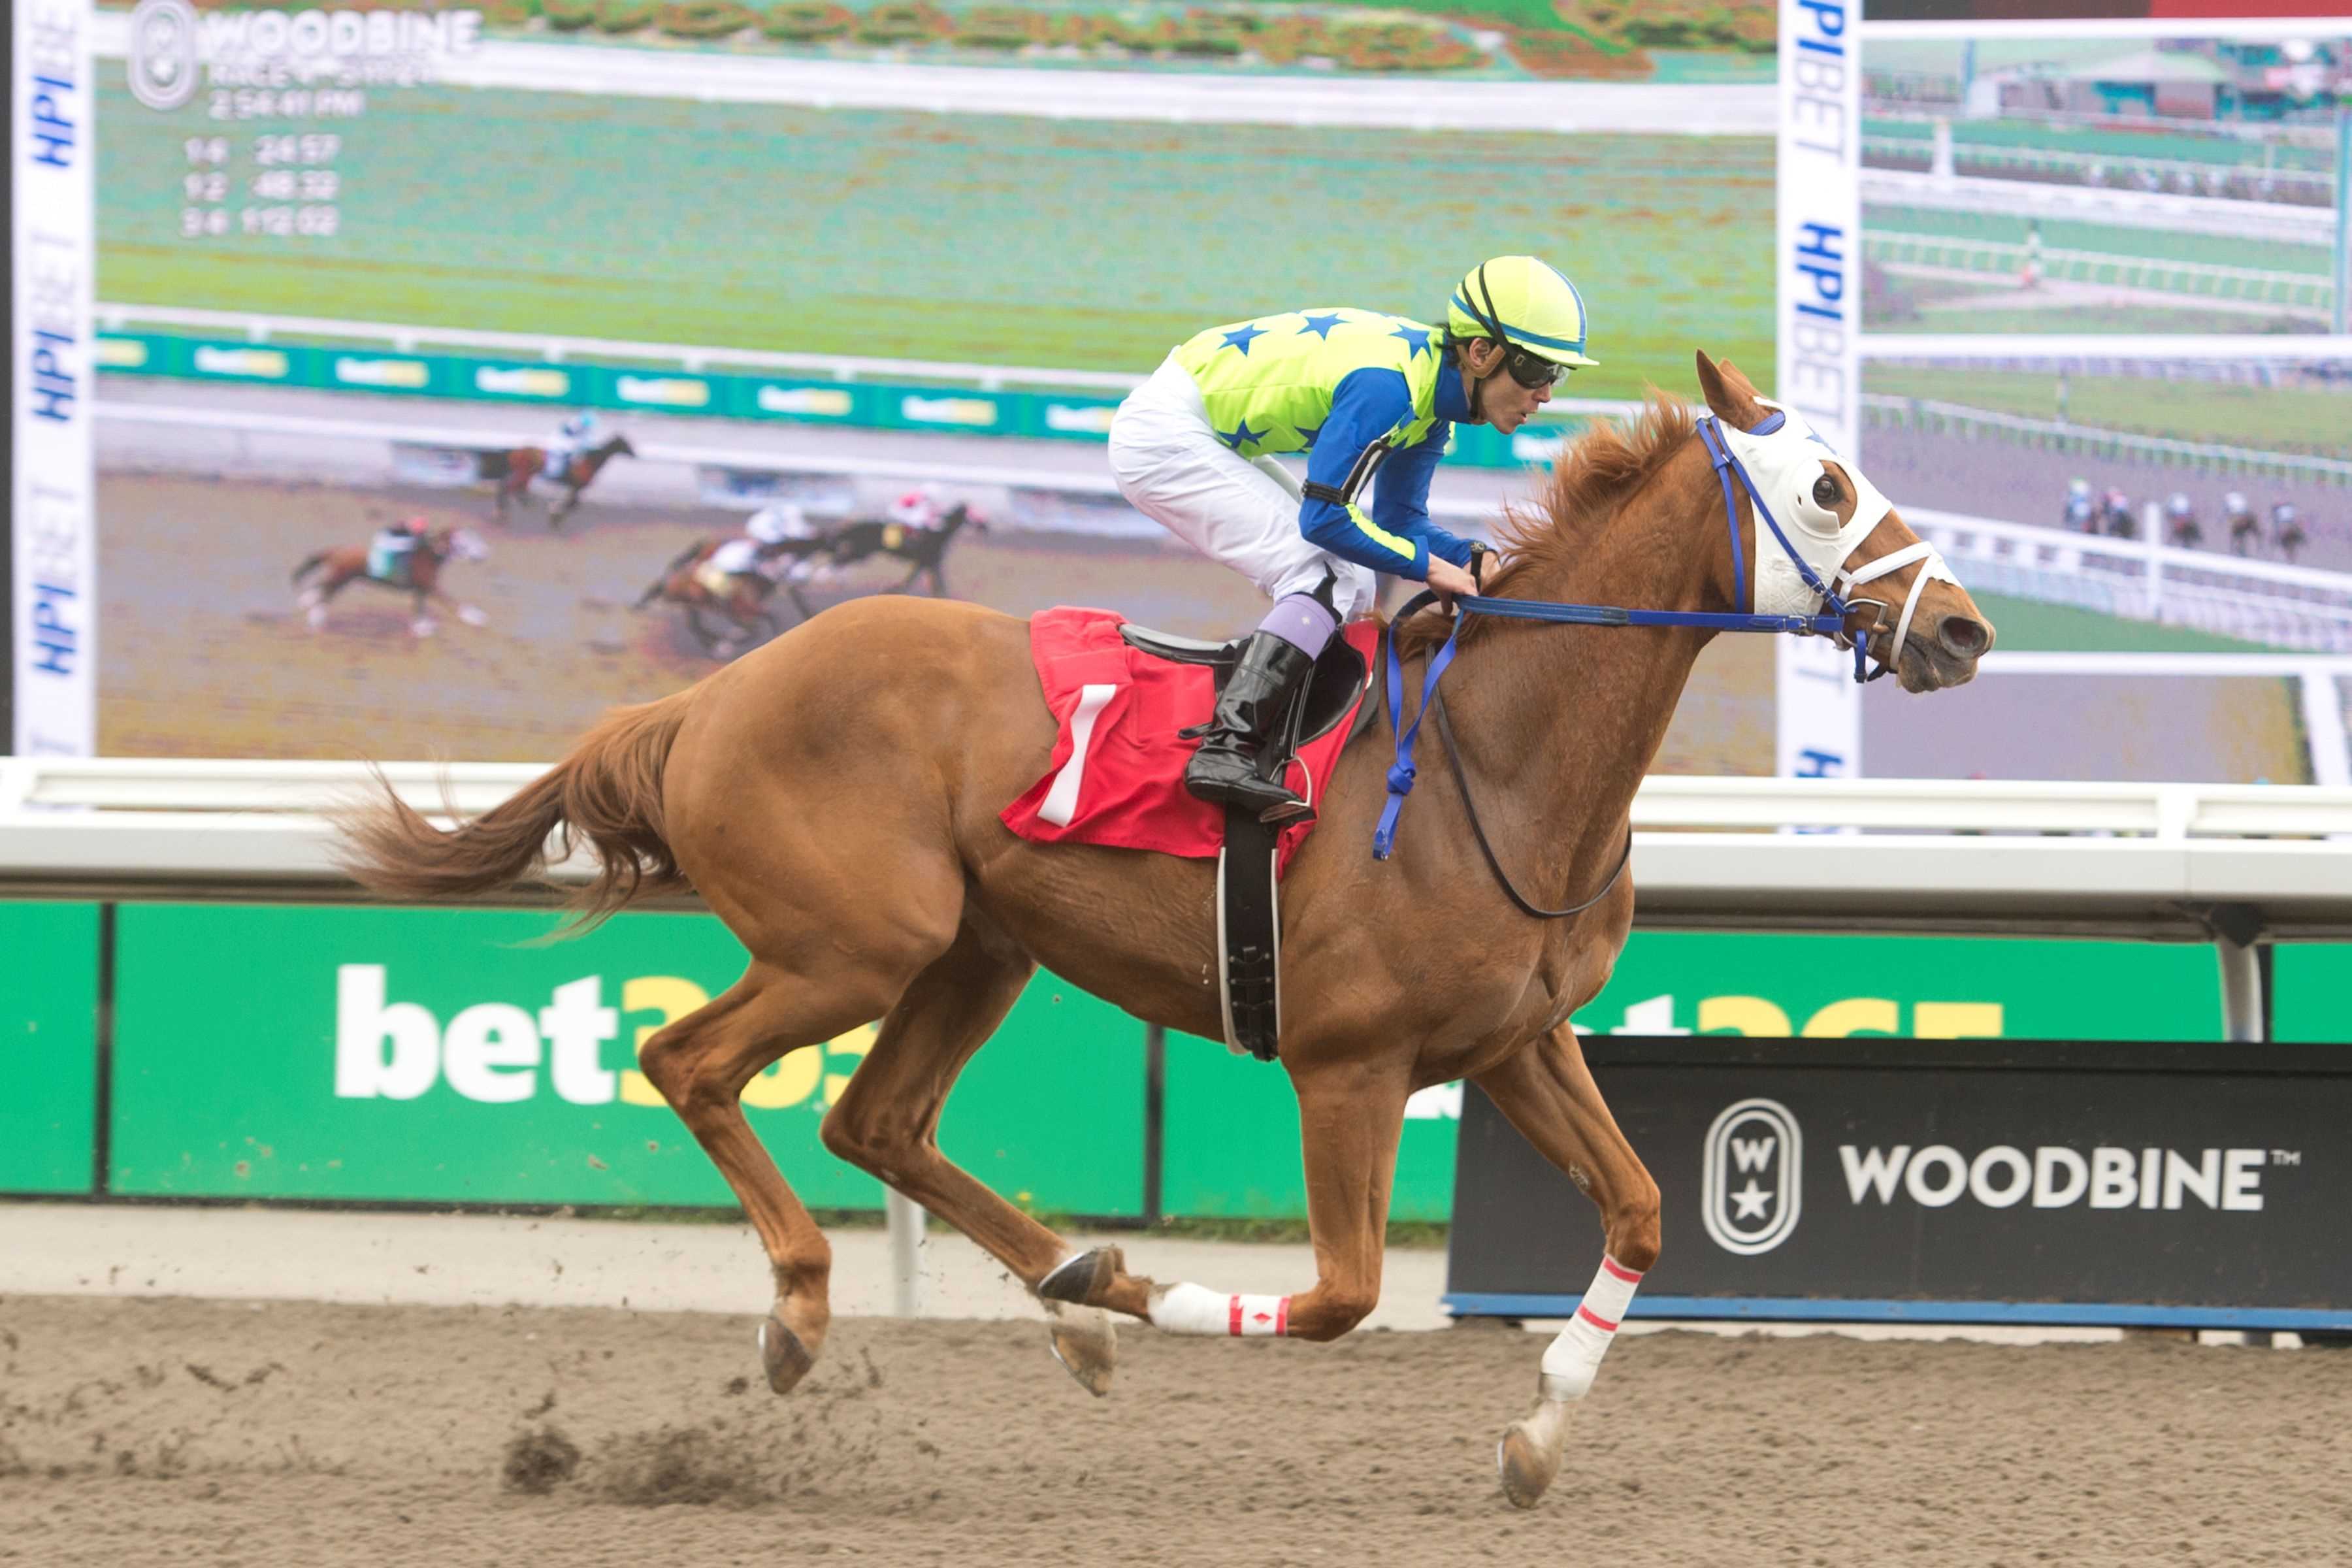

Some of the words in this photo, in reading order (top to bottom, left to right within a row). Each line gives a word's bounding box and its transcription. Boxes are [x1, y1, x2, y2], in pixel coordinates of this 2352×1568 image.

[204, 10, 483, 53] WOODBINE
[1793, 0, 1847, 165] PIBET
[1793, 221, 1846, 431] HPIBET
[335, 964, 879, 1109] bet3
[1839, 1145, 2266, 1211] WOODBINE
